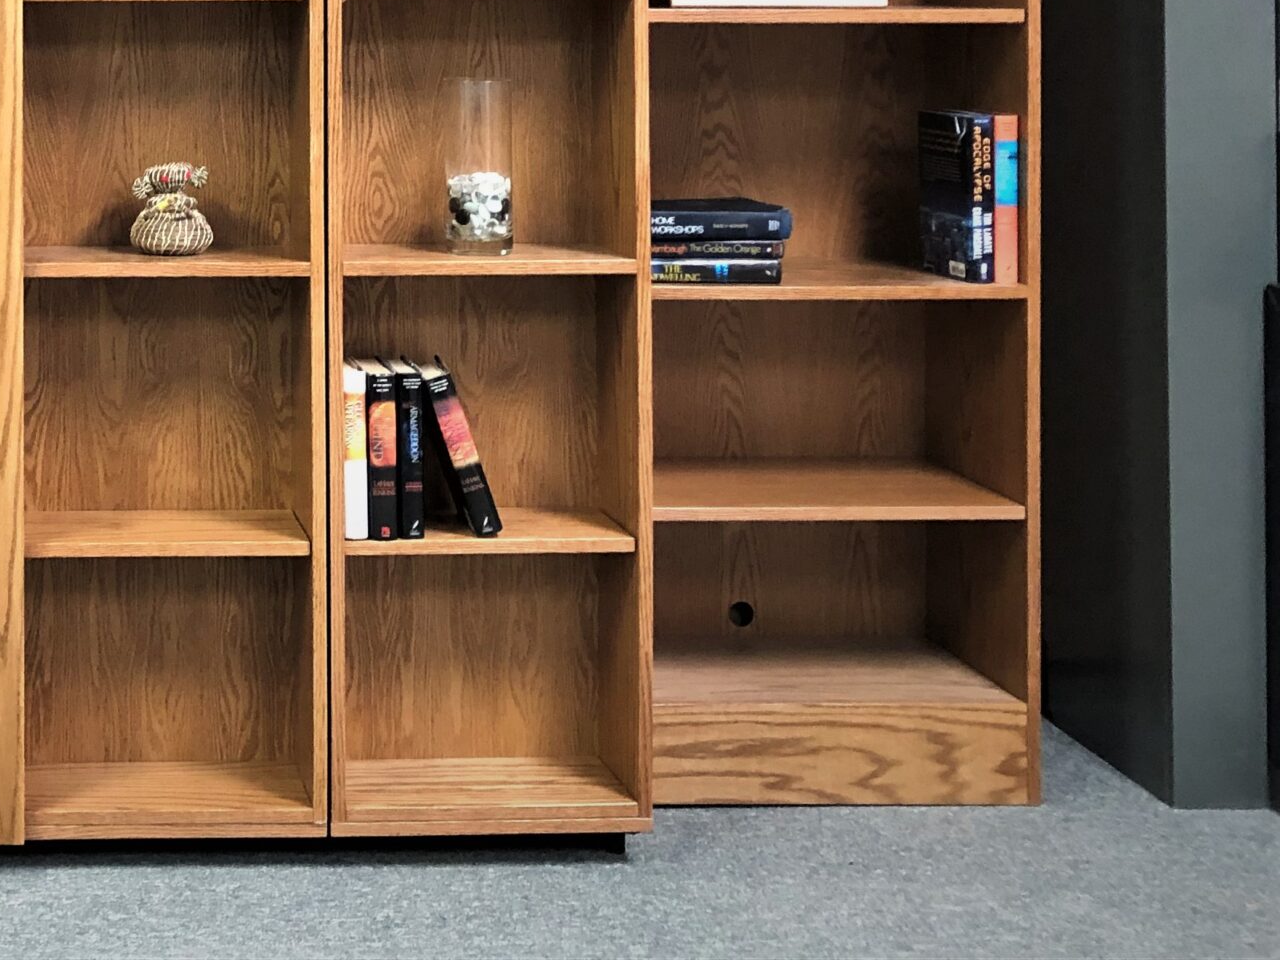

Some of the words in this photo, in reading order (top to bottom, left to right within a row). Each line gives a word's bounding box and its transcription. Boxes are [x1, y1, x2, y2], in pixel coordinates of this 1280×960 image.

[982, 137, 991, 170] EDGE
[972, 125, 983, 202] APOCALYPSE
[983, 174, 991, 190] OF
[651, 216, 676, 225] HOME
[651, 225, 705, 235] WORKSHOPS
[689, 243, 702, 252] The
[702, 243, 732, 254] Golden
[733, 243, 761, 255] Orange
[663, 264, 683, 273] THE
[409, 405, 421, 464] ARMAGEDDON
